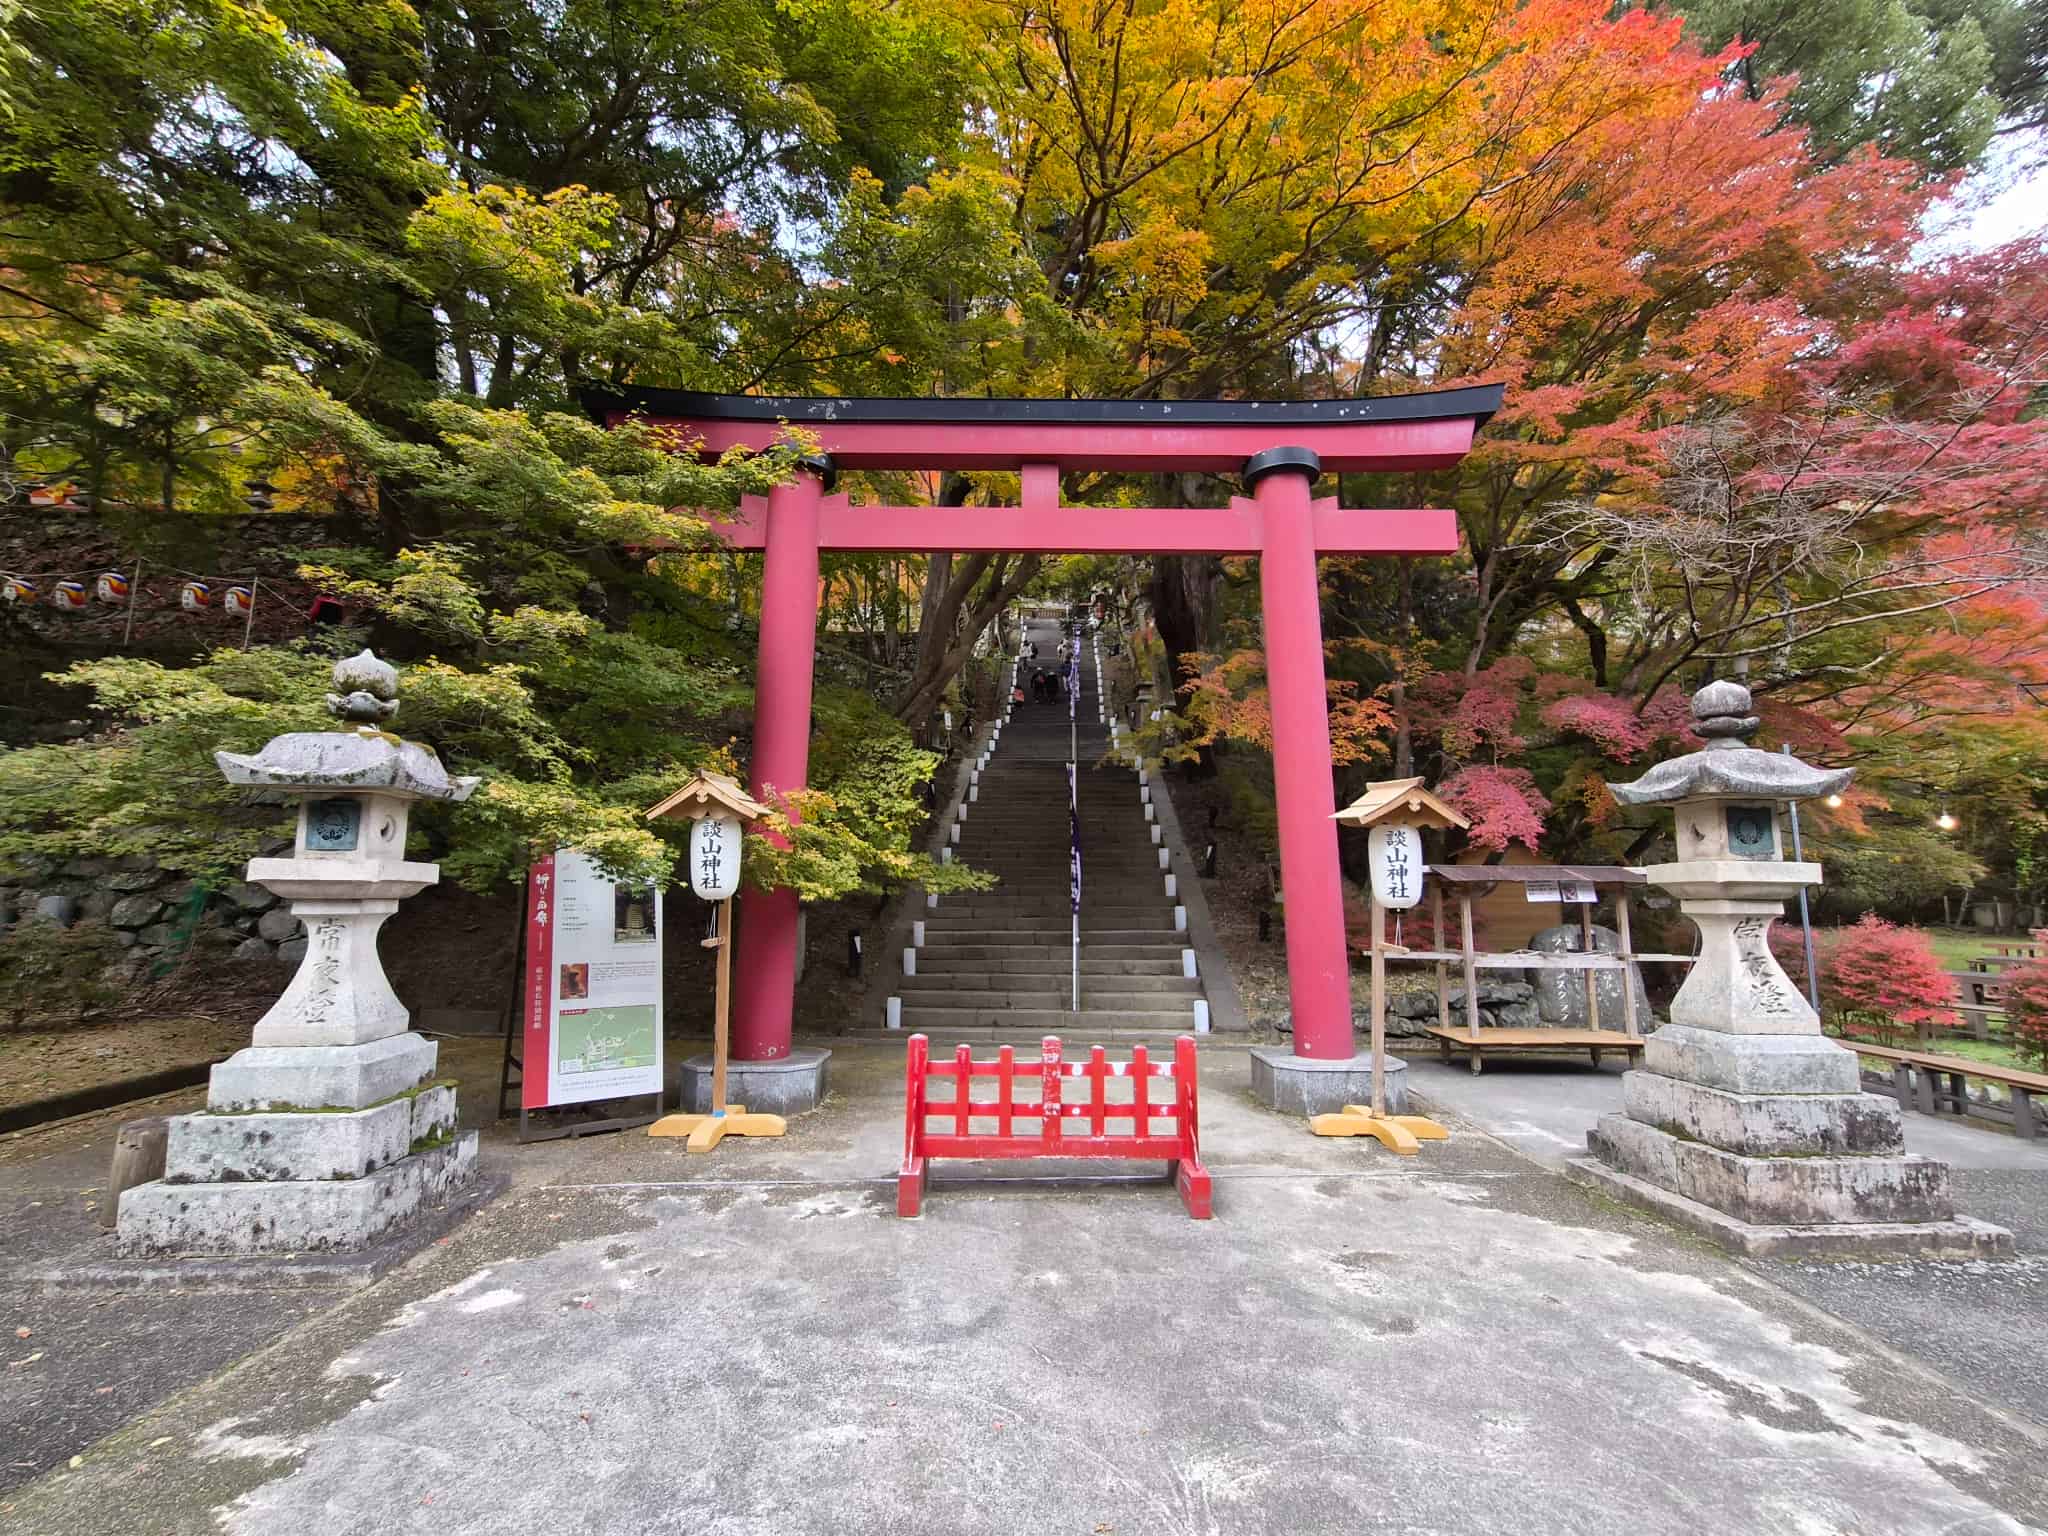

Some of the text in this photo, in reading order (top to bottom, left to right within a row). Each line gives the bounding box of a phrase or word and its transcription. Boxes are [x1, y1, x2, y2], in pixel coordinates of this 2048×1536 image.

[699, 821, 724, 890] 談山神社
[1384, 829, 1411, 898] 談山神社
